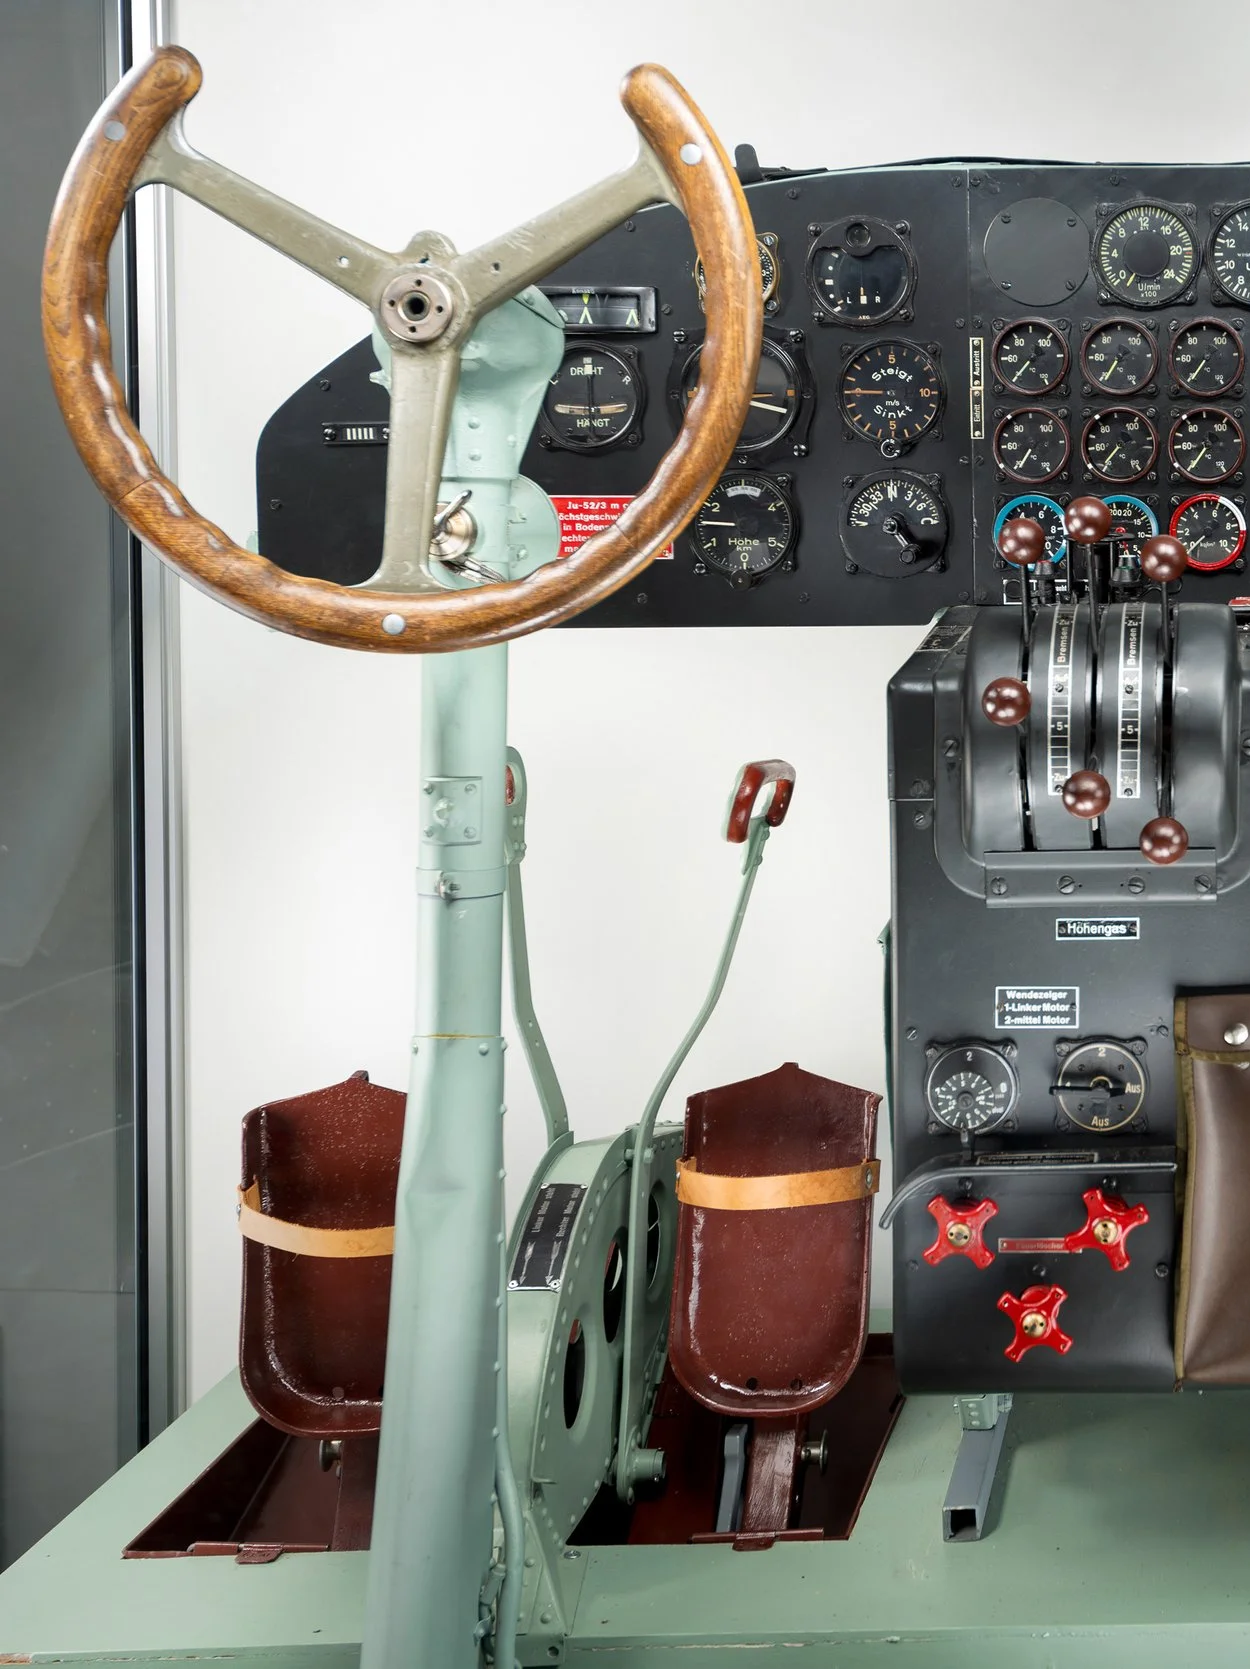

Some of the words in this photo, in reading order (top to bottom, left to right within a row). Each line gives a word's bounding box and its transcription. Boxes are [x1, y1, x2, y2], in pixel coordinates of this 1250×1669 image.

[1138, 217, 1149, 227] 12
[1160, 225, 1172, 235] 16
[1238, 223, 1249, 232] 14
[1118, 227, 1126, 238] 8
[1225, 239, 1236, 248] 12
[1111, 248, 1119, 258] 4
[1170, 245, 1182, 255] 20
[1224, 260, 1235, 270] 10
[1119, 270, 1126, 279] 0
[1163, 269, 1176, 279] 24
[1237, 275, 1245, 285] 8
[1137, 283, 1161, 291] U/min
[846, 296, 852, 304] L
[1014, 339, 1025, 347] 80
[1038, 339, 1051, 347] 100
[1101, 336, 1112, 344] 80
[1128, 337, 1142, 346] 100
[1188, 337, 1198, 345] 80
[1213, 337, 1227, 345] 100
[888, 354, 896, 364] 5
[1094, 353, 1105, 361] 60
[1181, 355, 1191, 363] 60
[871, 366, 913, 382] Steigt
[622, 375, 632, 385] R
[920, 388, 931, 397] 10
[873, 404, 913, 419] Sinkt
[889, 420, 897, 430] 5
[1013, 425, 1024, 433] 80
[1040, 424, 1053, 433] 100
[1007, 442, 1018, 450] 60
[887, 485, 898, 498] N
[904, 490, 913, 501] 3
[869, 491, 884, 504] 33
[711, 502, 720, 512] 2
[767, 503, 776, 512] 4
[859, 503, 873, 517] 30
[916, 502, 927, 511] 6
[1038, 510, 1045, 519] 6
[1193, 512, 1199, 520] 4
[1212, 510, 1218, 518] 6
[1050, 525, 1057, 534] 8
[1184, 528, 1190, 536] 2
[711, 537, 716, 547] 1
[728, 537, 760, 546] Höhe
[768, 537, 777, 547] 5
[740, 552, 749, 562] 0
[1057, 626, 1068, 663] Bremsen
[1126, 627, 1138, 665] Bremsen
[1056, 722, 1063, 730] 5
[1126, 725, 1134, 734] 5
[1066, 921, 1127, 937] Höhengas
[1006, 991, 1068, 999] Wendezeiger
[1004, 1003, 1042, 1012] 1-Linker
[1042, 1003, 1070, 1012] Motor
[1004, 1015, 1041, 1025] 2-mittel
[1042, 1015, 1071, 1025] Motor
[966, 1051, 973, 1062] 2
[1098, 1047, 1106, 1057] 2
[1125, 1082, 1141, 1094] Aus
[1091, 1116, 1109, 1127] Aus
